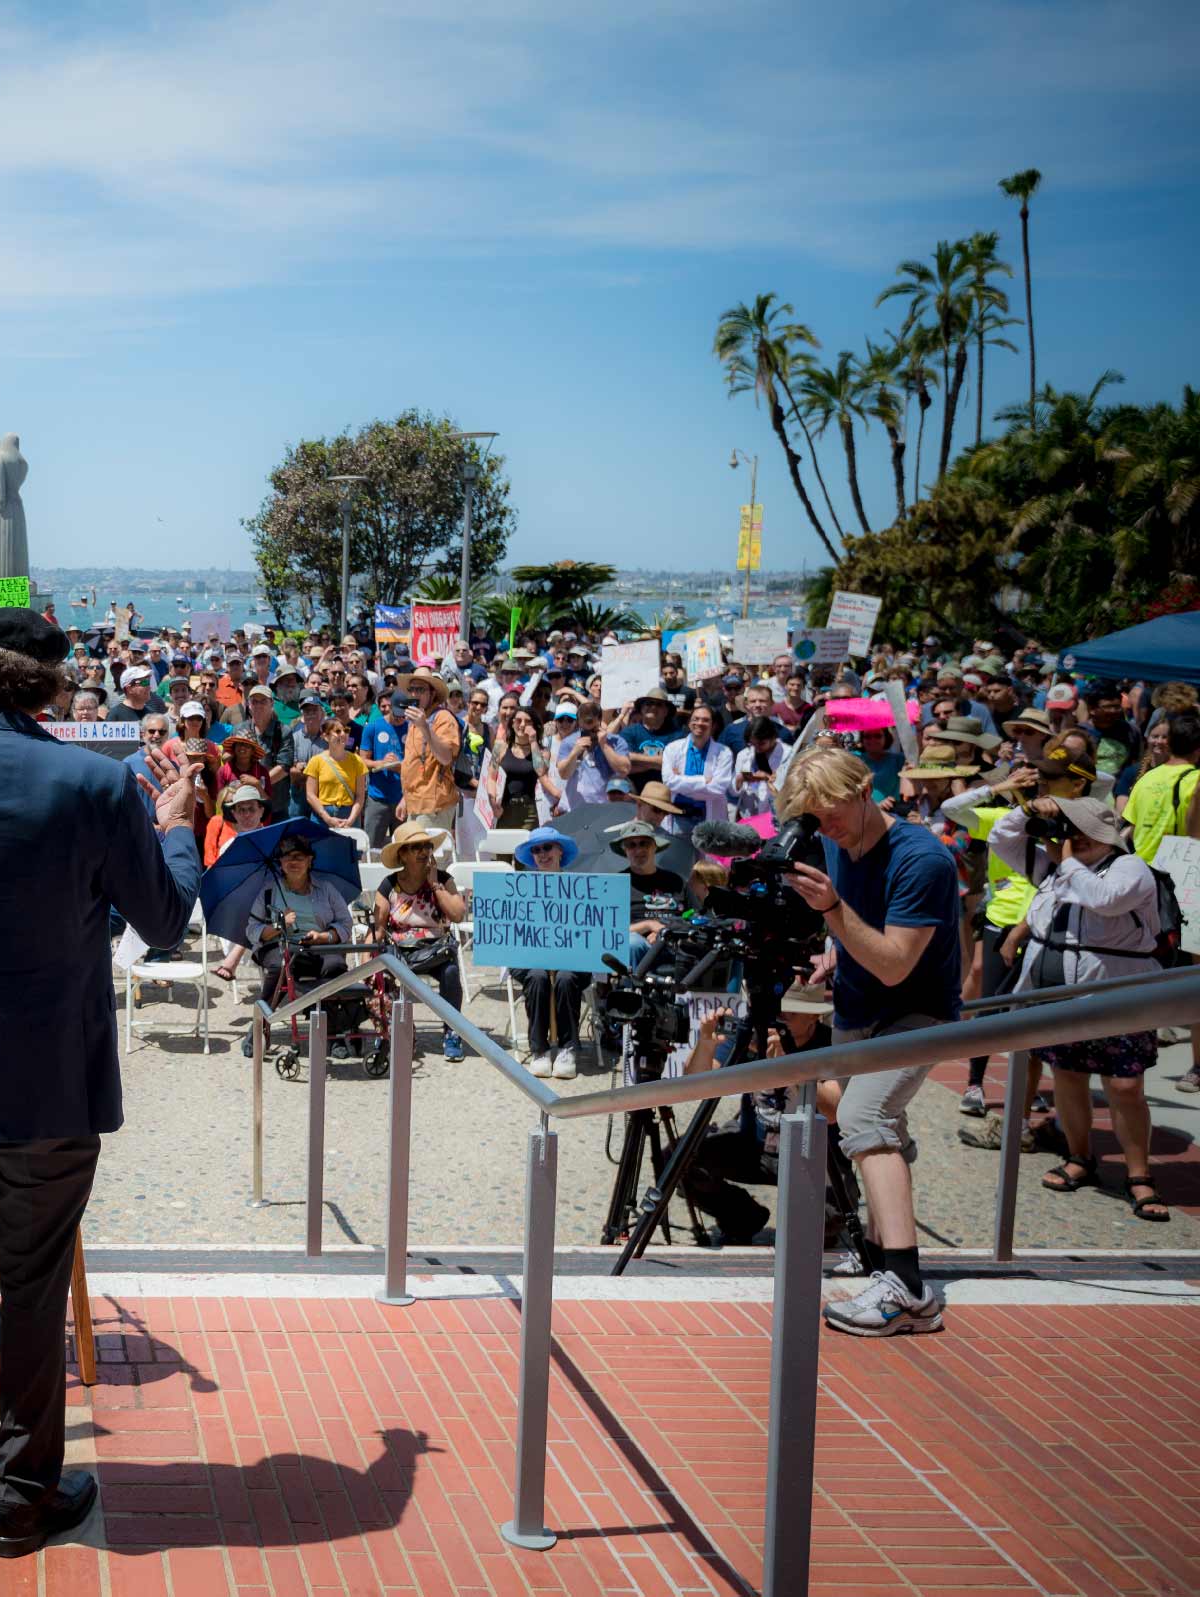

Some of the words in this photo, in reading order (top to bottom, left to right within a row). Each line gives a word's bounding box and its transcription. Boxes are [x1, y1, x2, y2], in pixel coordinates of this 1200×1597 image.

[79, 723, 89, 738] Is
[92, 723, 99, 738] A
[102, 723, 136, 738] Candle
[473, 897, 536, 922] BECAUSE
[542, 900, 569, 925] YOU
[573, 903, 620, 929] CAN'T
[473, 920, 512, 946] JUST
[514, 922, 552, 948] MAKE
[601, 929, 625, 951] UP
